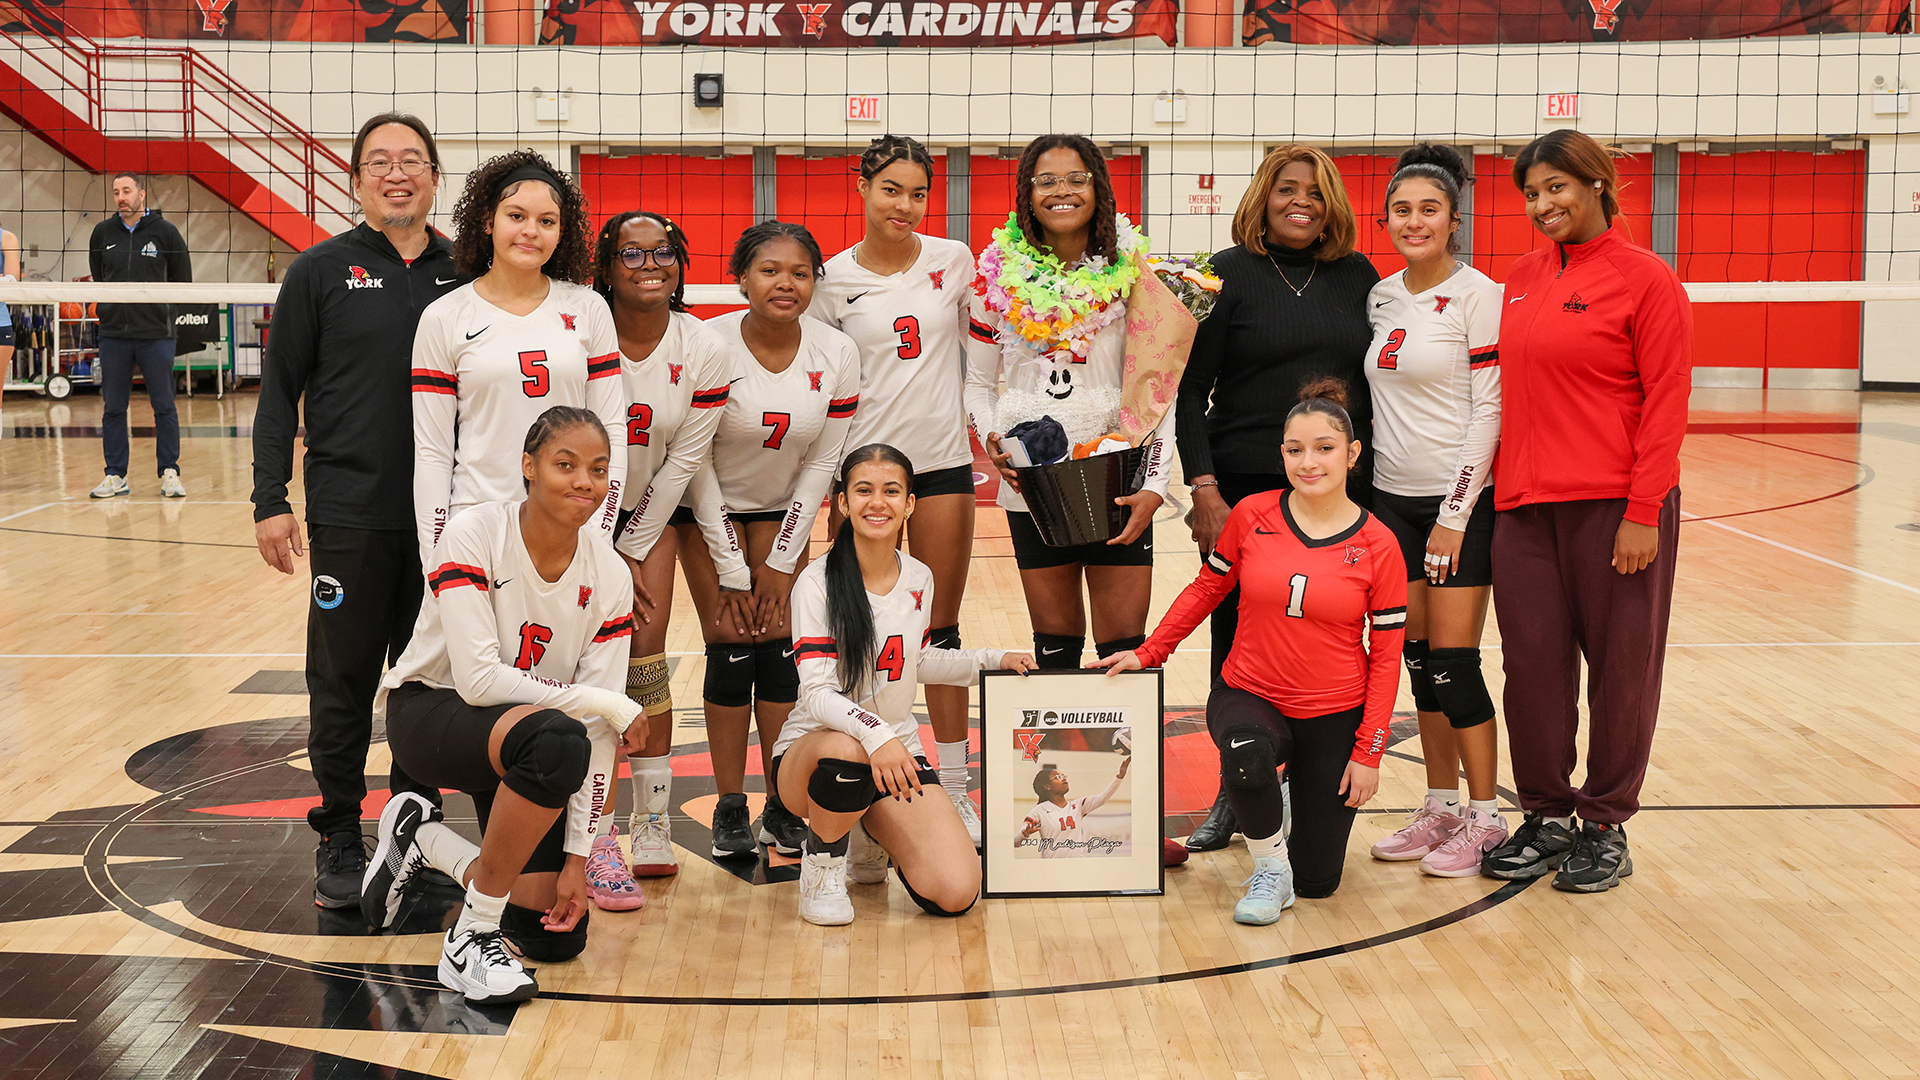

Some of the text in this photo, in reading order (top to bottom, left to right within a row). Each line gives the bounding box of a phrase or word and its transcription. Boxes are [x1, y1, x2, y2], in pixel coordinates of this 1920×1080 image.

[633, 2, 784, 36] YORK
[842, 0, 1136, 37] CARDINALS
[849, 97, 879, 119] EXIT
[1548, 95, 1579, 116] EXIT
[1188, 194, 1223, 204] EMERGENCY
[1189, 205, 1222, 215] EXIT ONLY
[345, 277, 384, 290] YORK
[893, 315, 922, 361] 3
[1376, 328, 1407, 371] 2
[518, 349, 551, 399] 5
[761, 410, 791, 451] 7
[600, 479, 621, 532] CARDINALS
[624, 485, 655, 535] CARDINALS
[777, 500, 803, 552] CARDINALS
[1286, 573, 1309, 619] 1
[513, 620, 554, 671] 16
[876, 634, 905, 682] 4
[1061, 712, 1124, 724] VOLLEYBALL
[587, 773, 606, 834] CARDINALS
[1058, 815, 1076, 832] 14
[1037, 837, 1092, 853] Madison
